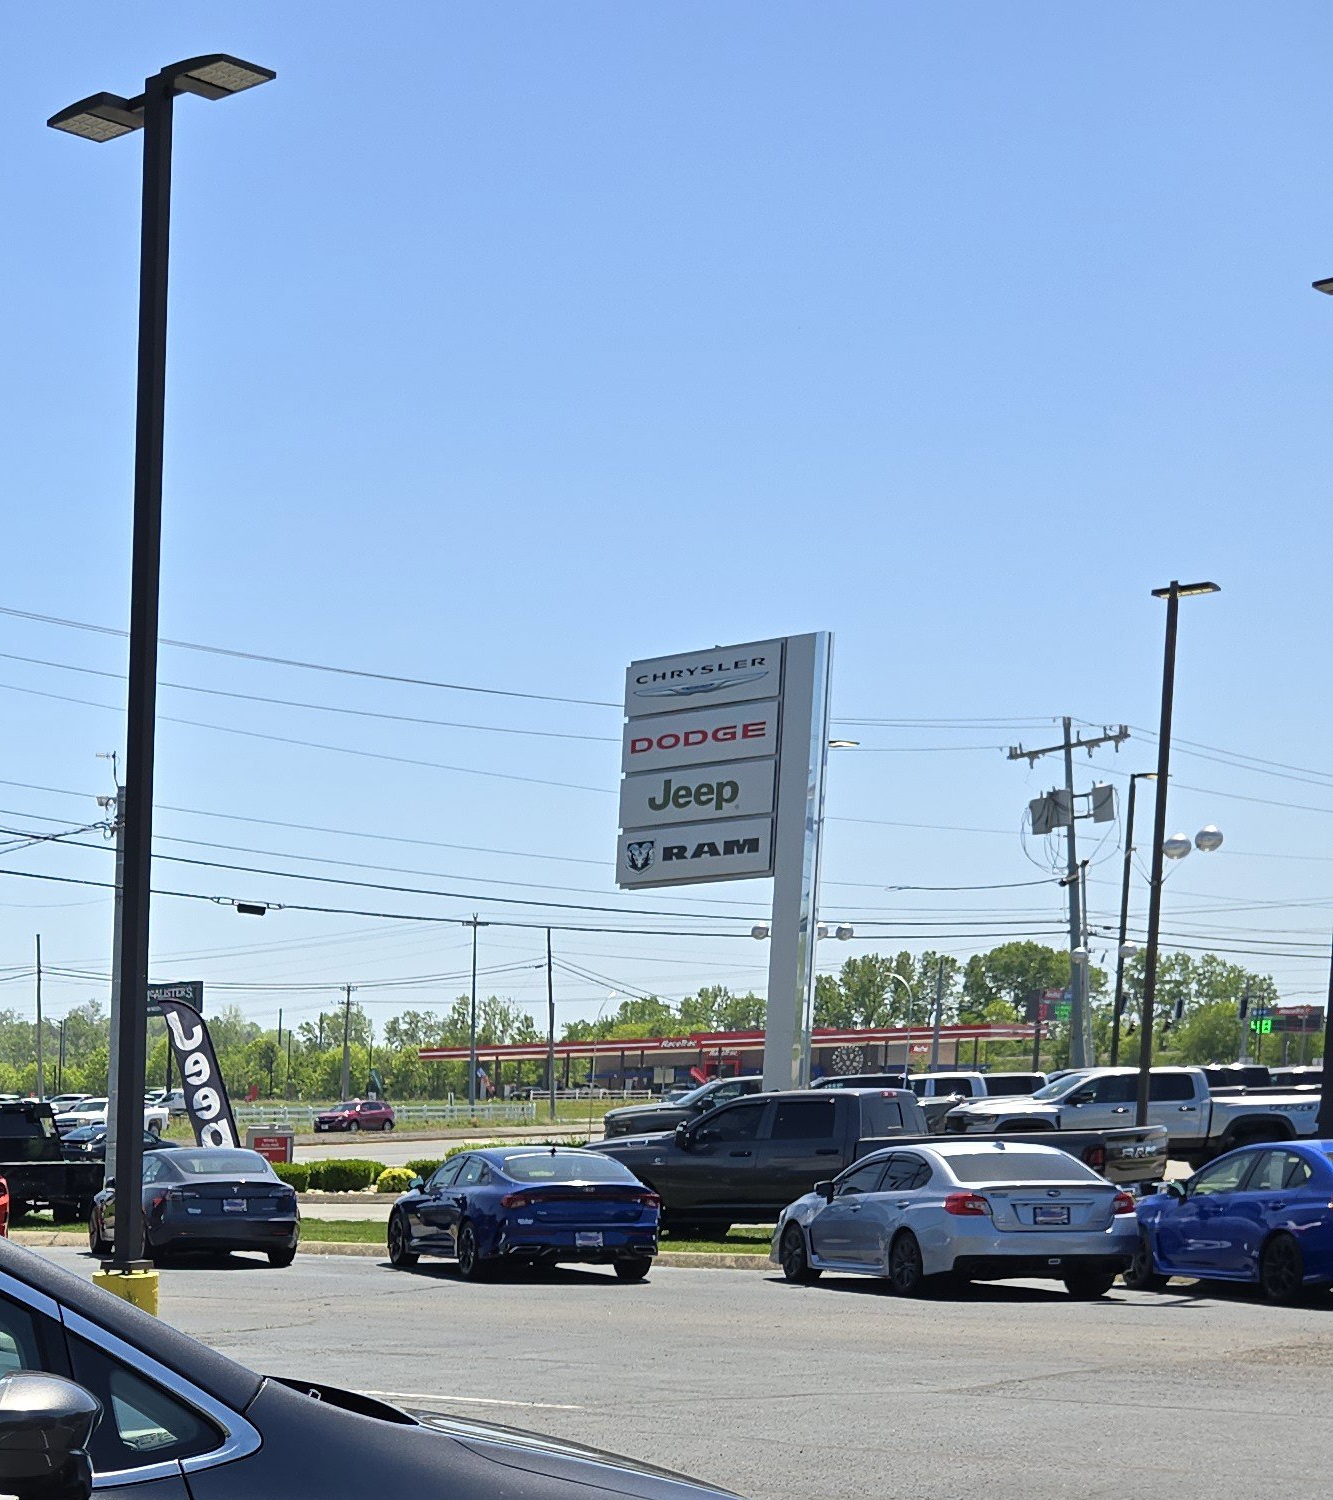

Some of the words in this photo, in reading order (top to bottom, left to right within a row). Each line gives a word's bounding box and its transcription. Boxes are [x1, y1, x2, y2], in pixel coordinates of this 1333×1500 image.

[636, 657, 765, 684] CHRYSLER
[630, 721, 766, 754] DODGE
[648, 779, 739, 811] Jeep
[662, 838, 760, 861] RAM
